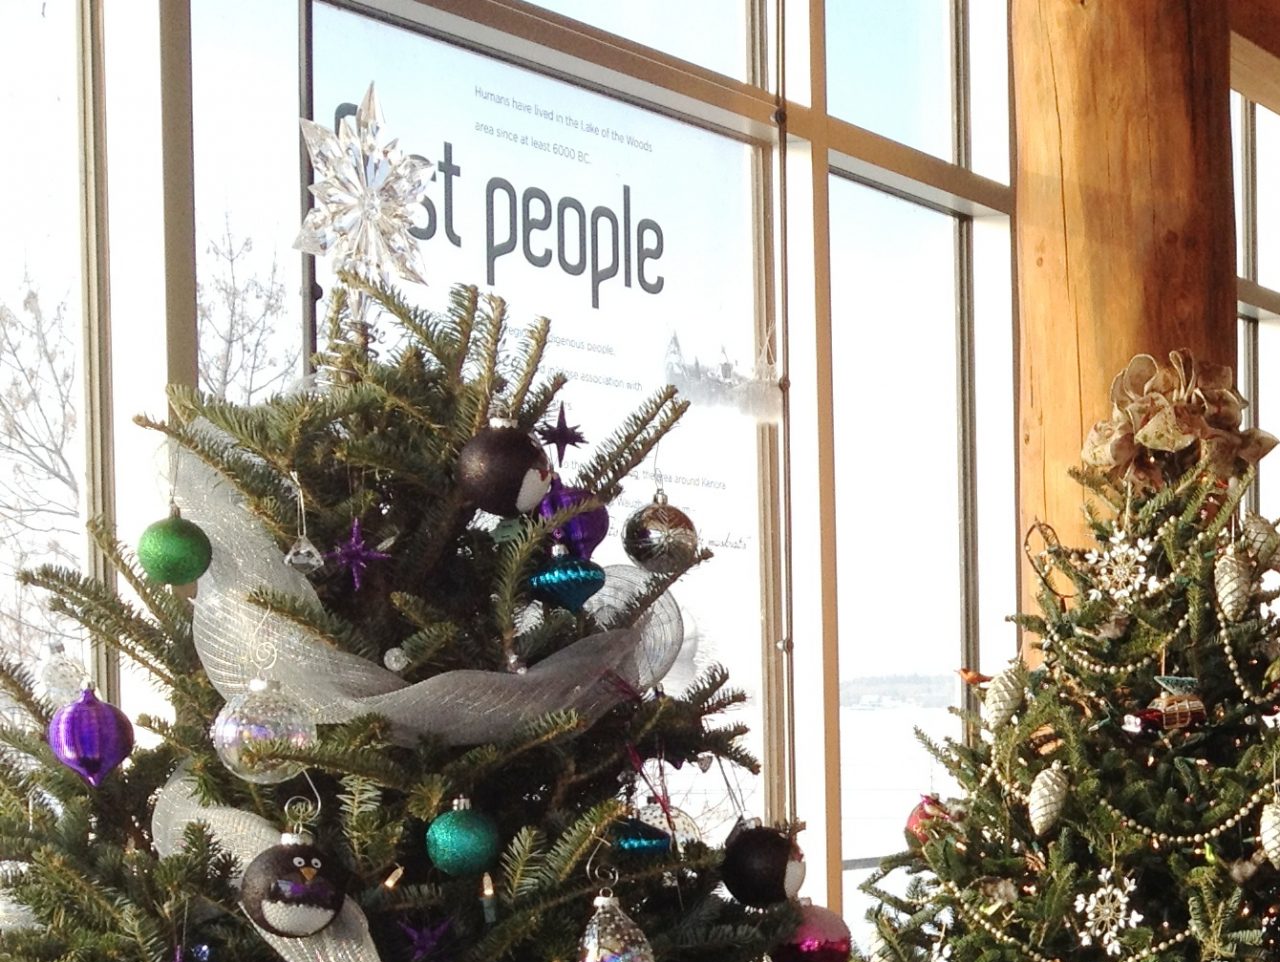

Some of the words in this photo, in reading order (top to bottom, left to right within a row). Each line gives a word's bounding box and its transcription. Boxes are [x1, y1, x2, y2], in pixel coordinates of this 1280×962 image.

[474, 122, 494, 136] area
[496, 128, 518, 143] since
[520, 136, 529, 146] at
[531, 137, 551, 153] least
[552, 143, 576, 160] 6000
[475, 86, 510, 107] Humans
[512, 97, 532, 114] have
[534, 104, 554, 121] lived
[556, 113, 564, 124] in
[565, 115, 579, 129] the
[580, 120, 600, 136] Lake
[601, 128, 610, 139] of
[611, 130, 625, 144] the
[626, 135, 653, 153] Woods
[485, 176, 665, 309] people
[626, 380, 643, 392] with
